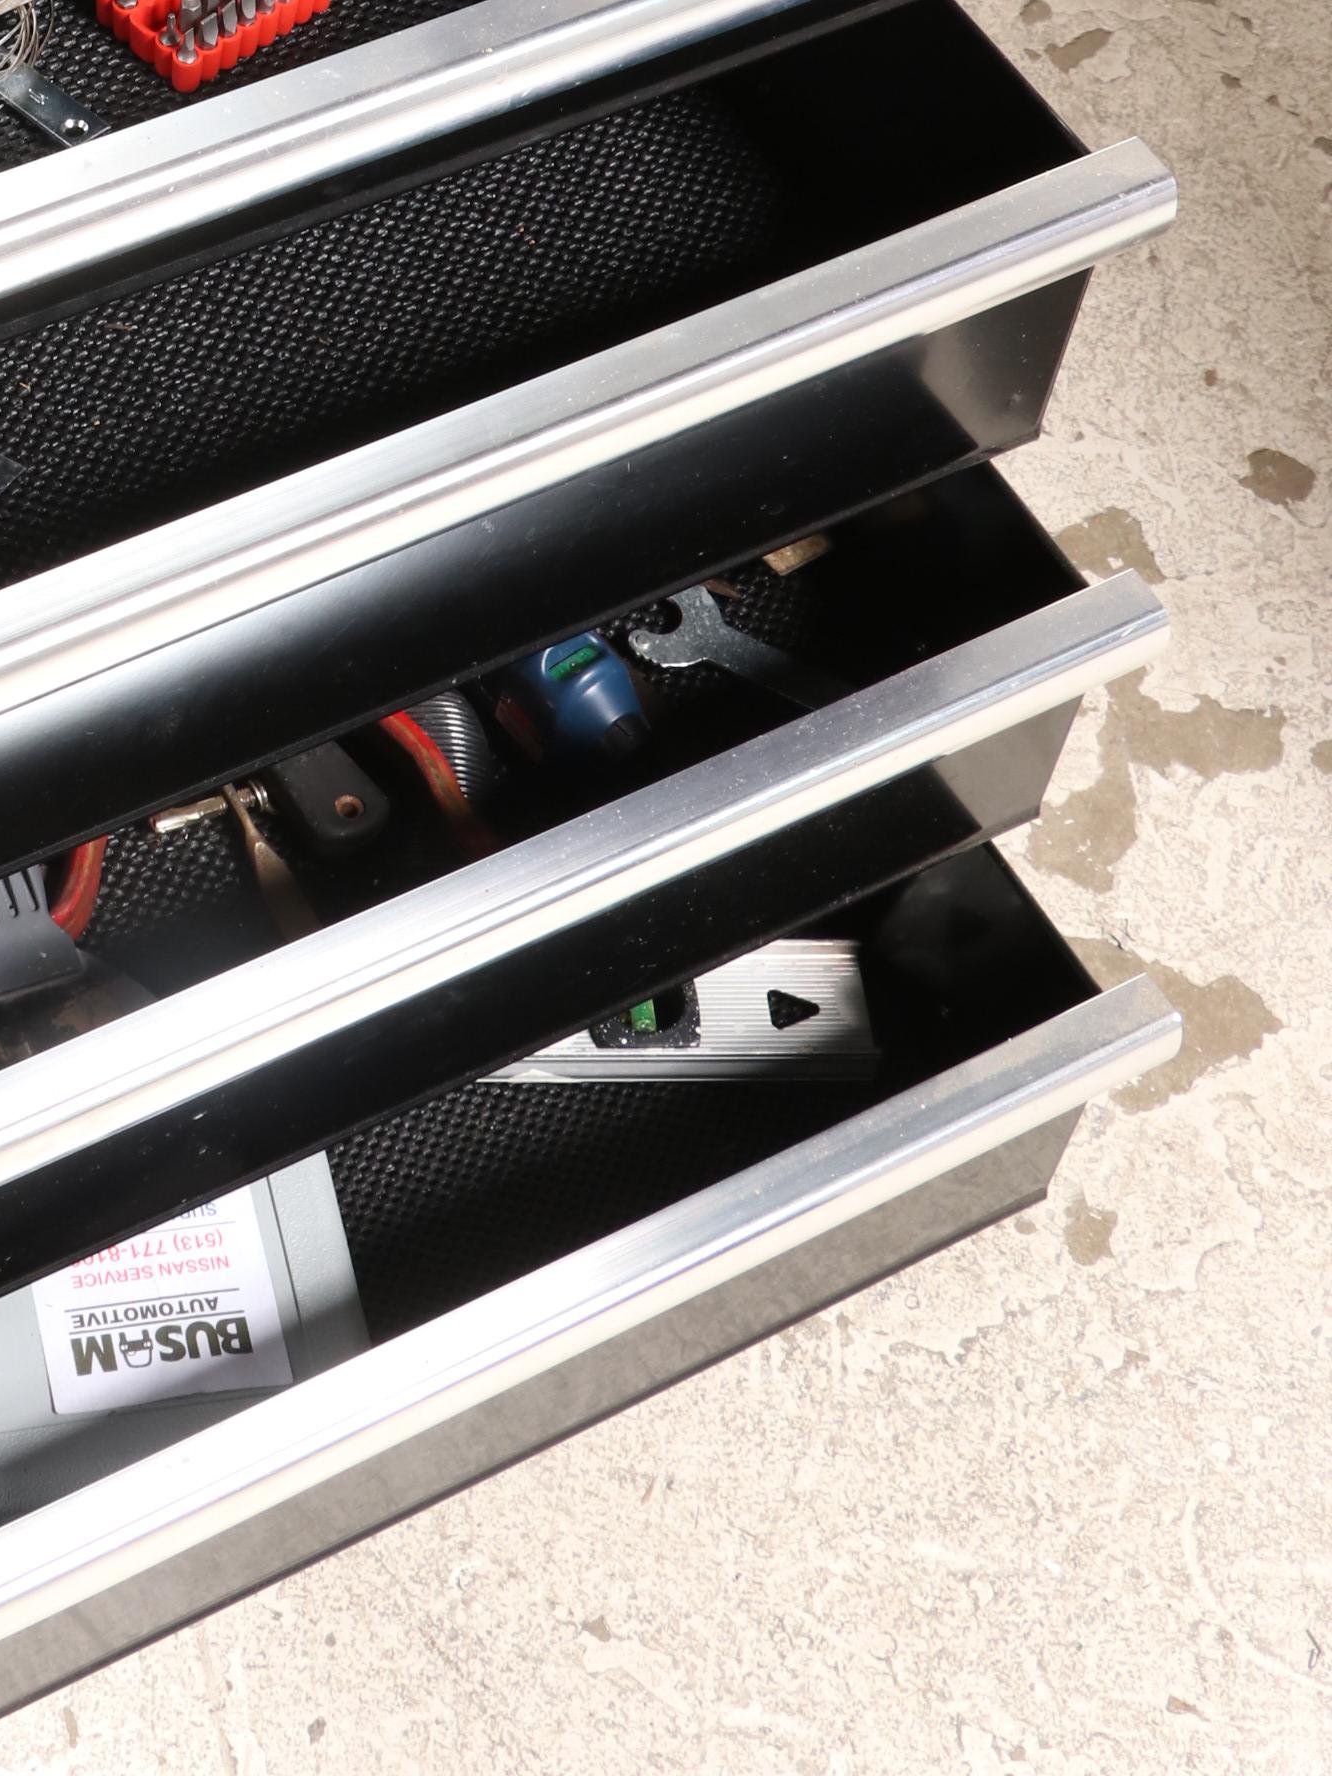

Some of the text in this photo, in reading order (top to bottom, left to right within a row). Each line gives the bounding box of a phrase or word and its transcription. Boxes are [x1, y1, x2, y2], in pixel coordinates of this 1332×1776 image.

[71, 1229, 223, 1268] (513) 771-81
[71, 1254, 231, 1290] NISSAN SERVICE
[71, 1295, 219, 1330] AUTOMOTIVE
